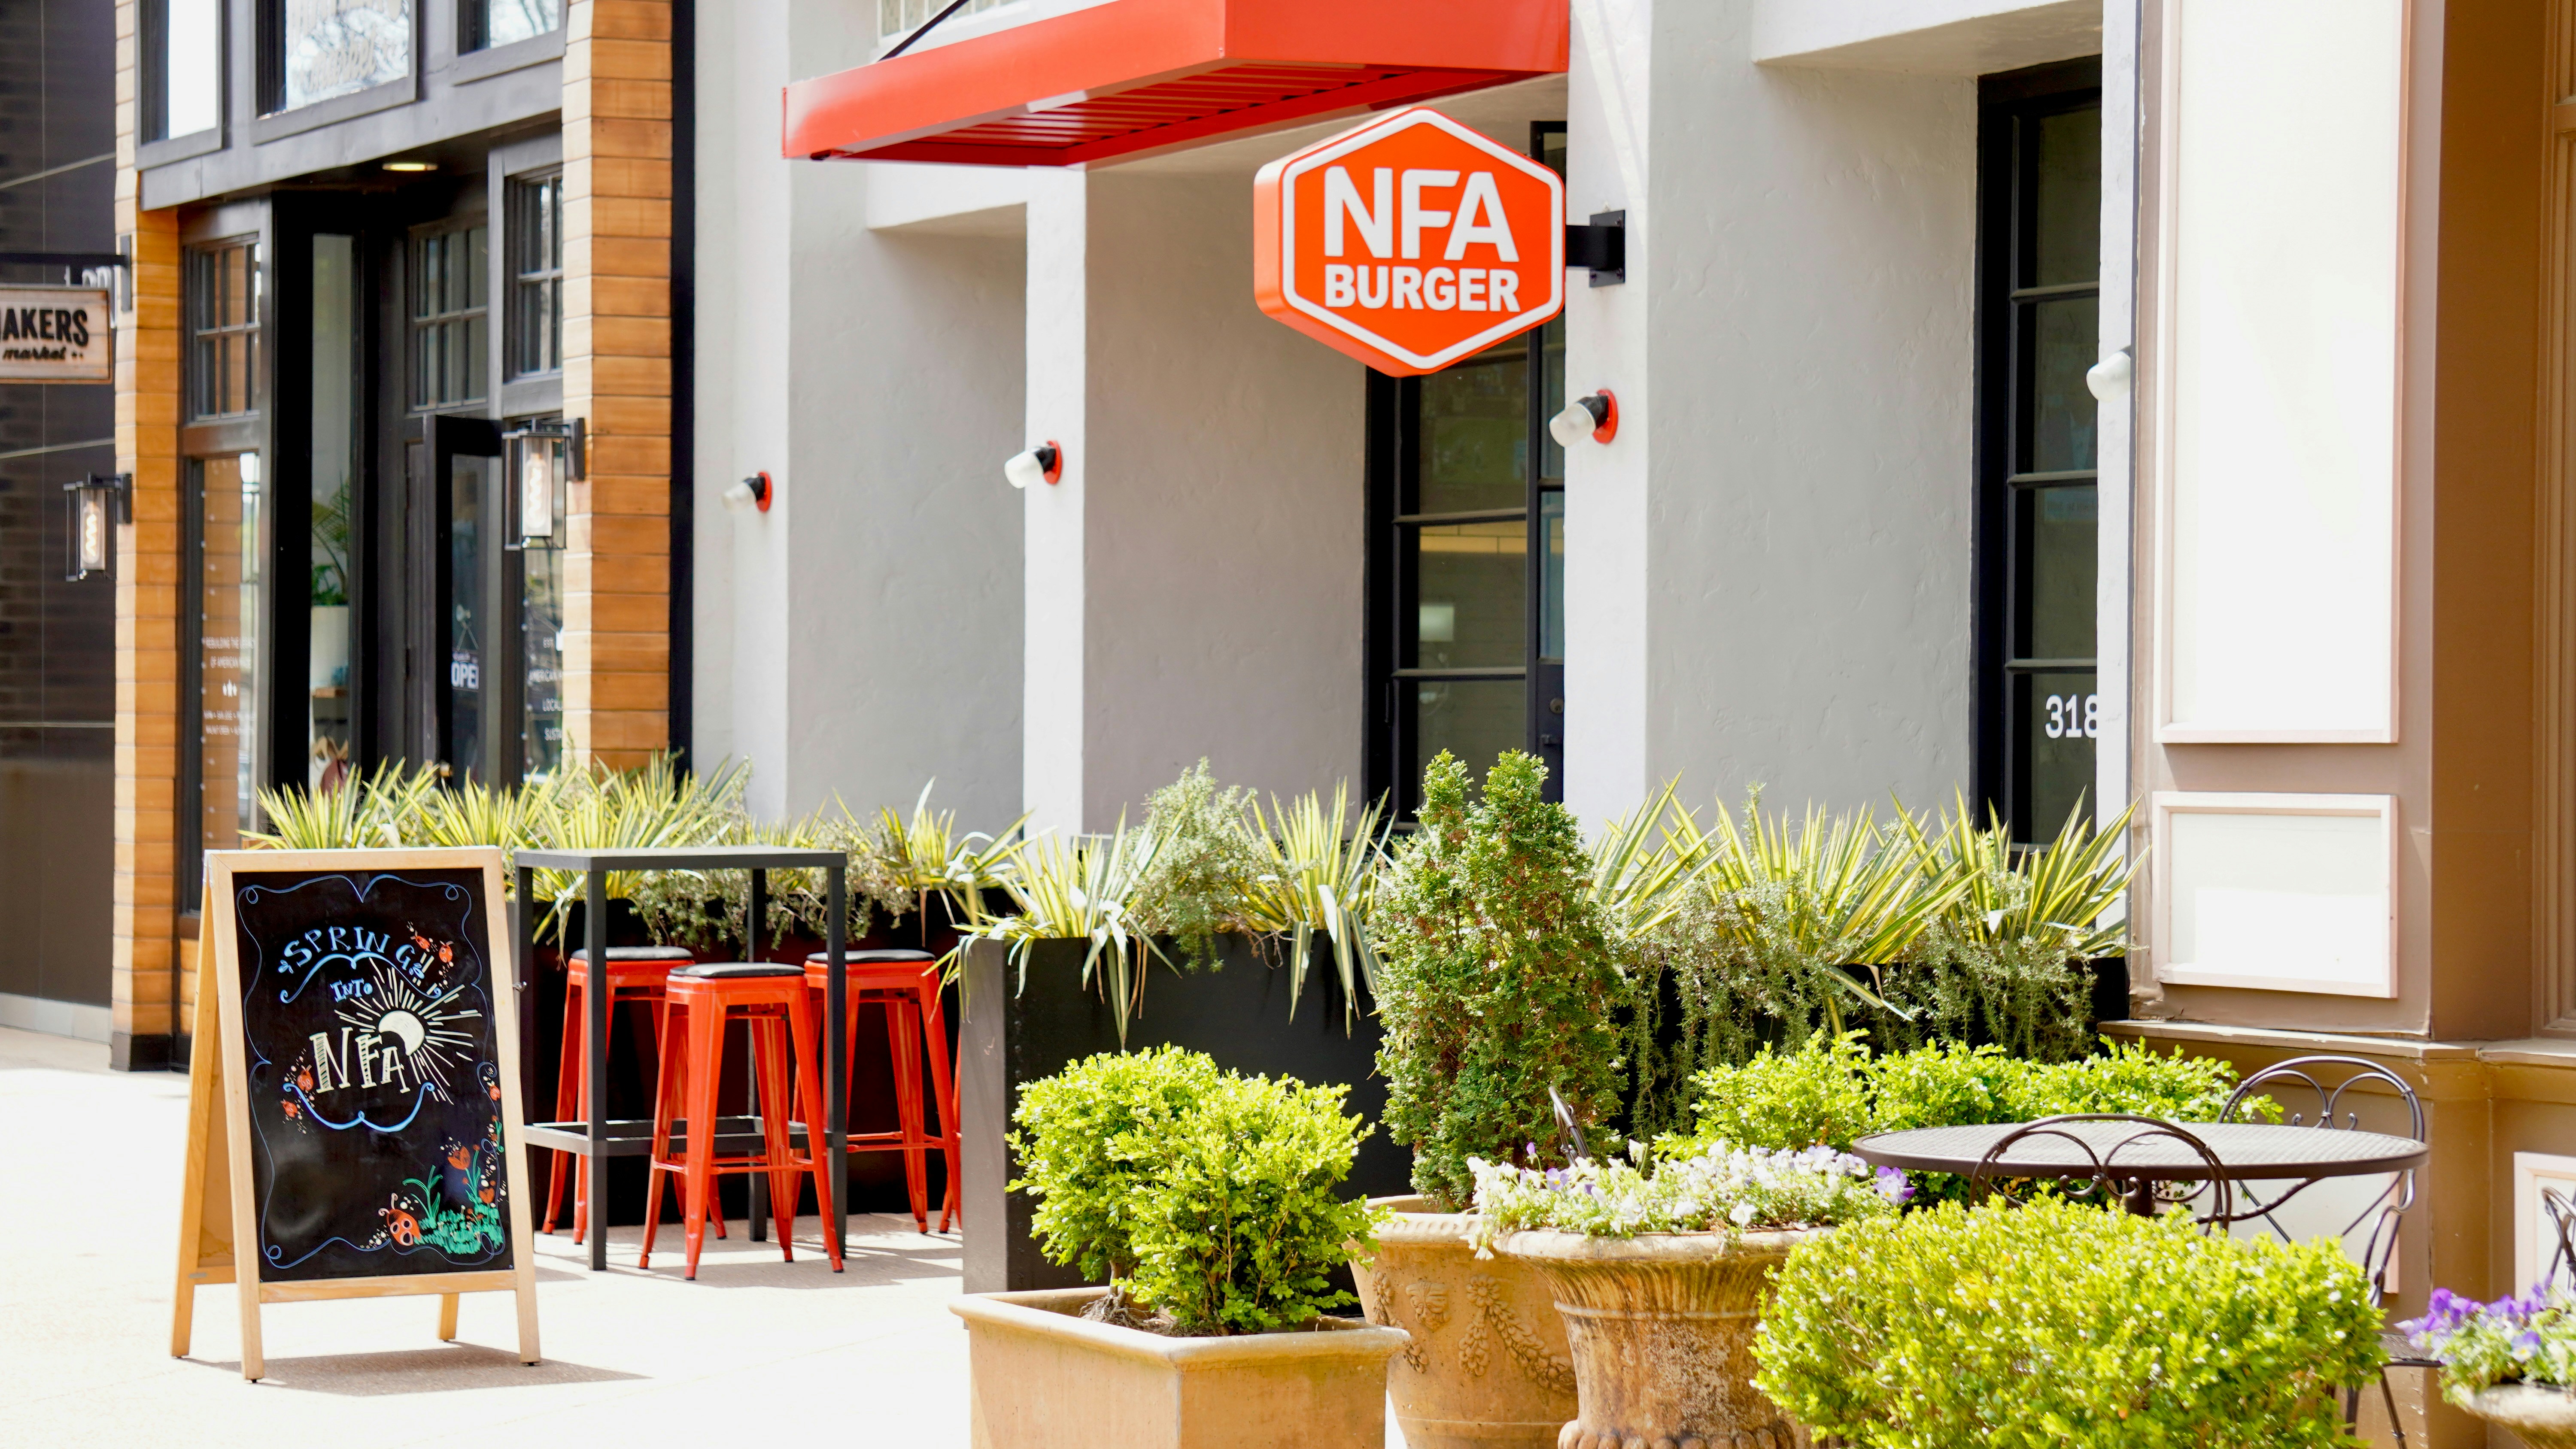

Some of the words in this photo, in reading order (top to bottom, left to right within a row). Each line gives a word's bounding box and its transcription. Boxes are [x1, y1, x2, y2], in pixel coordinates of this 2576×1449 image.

[1324, 166, 1519, 262] NFA
[1324, 264, 1520, 312] BURGER
[0, 308, 89, 347] AKERS
[2, 346, 66, 360] market
[2045, 694, 2097, 739] 318
[283, 925, 415, 971] SPRING
[309, 1027, 410, 1094] NFA
